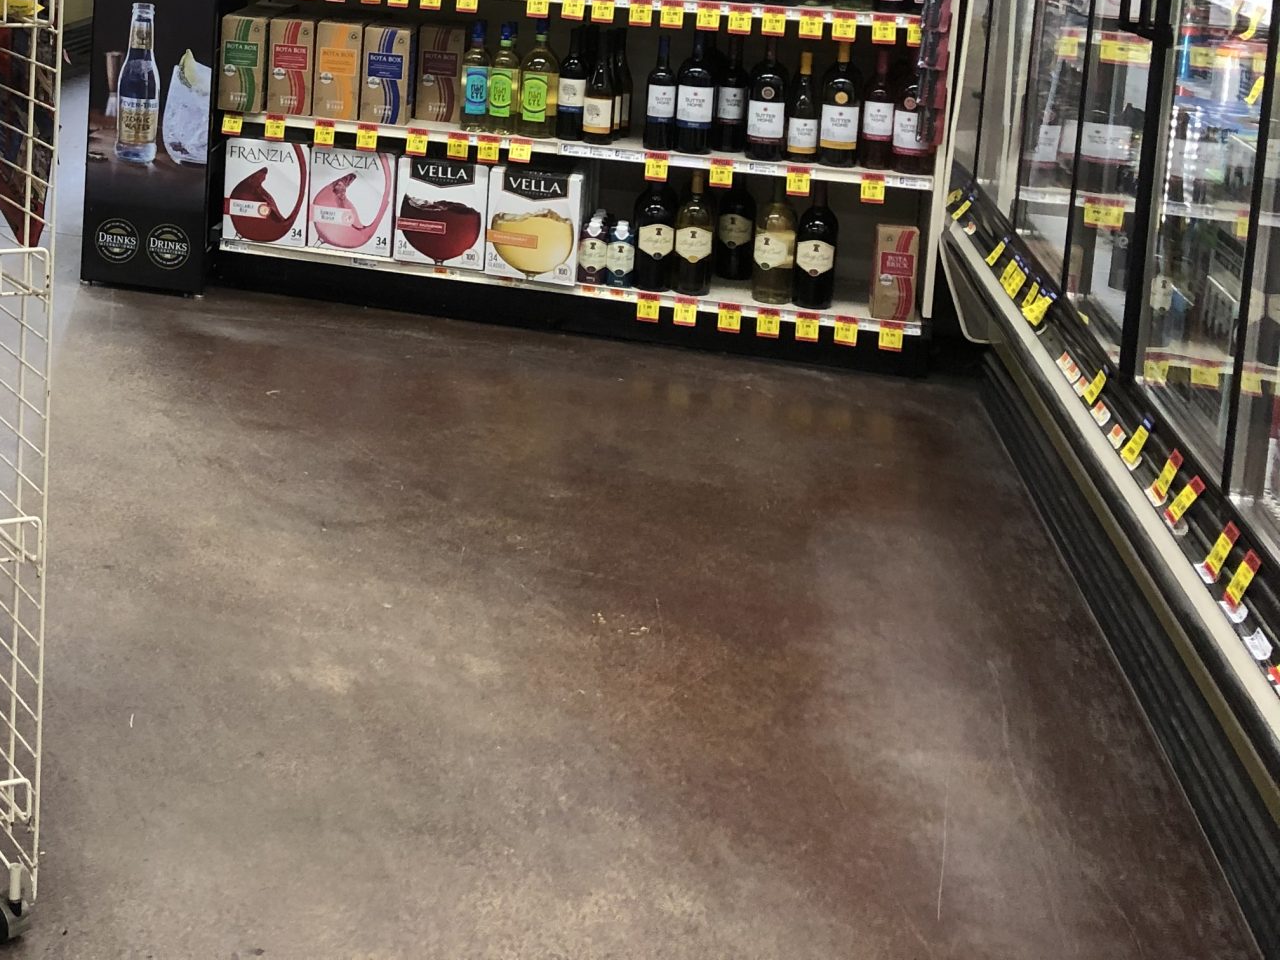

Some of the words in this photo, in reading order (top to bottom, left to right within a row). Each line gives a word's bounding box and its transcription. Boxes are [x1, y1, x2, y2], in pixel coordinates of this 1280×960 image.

[230, 145, 295, 163] FRANZIA
[314, 151, 380, 171] FRANZIA
[417, 164, 468, 180] VELLA
[509, 176, 562, 194] VELLA
[291, 228, 302, 238] 34
[376, 237, 387, 246] 34
[398, 240, 408, 250] 34
[488, 252, 498, 262] 34
